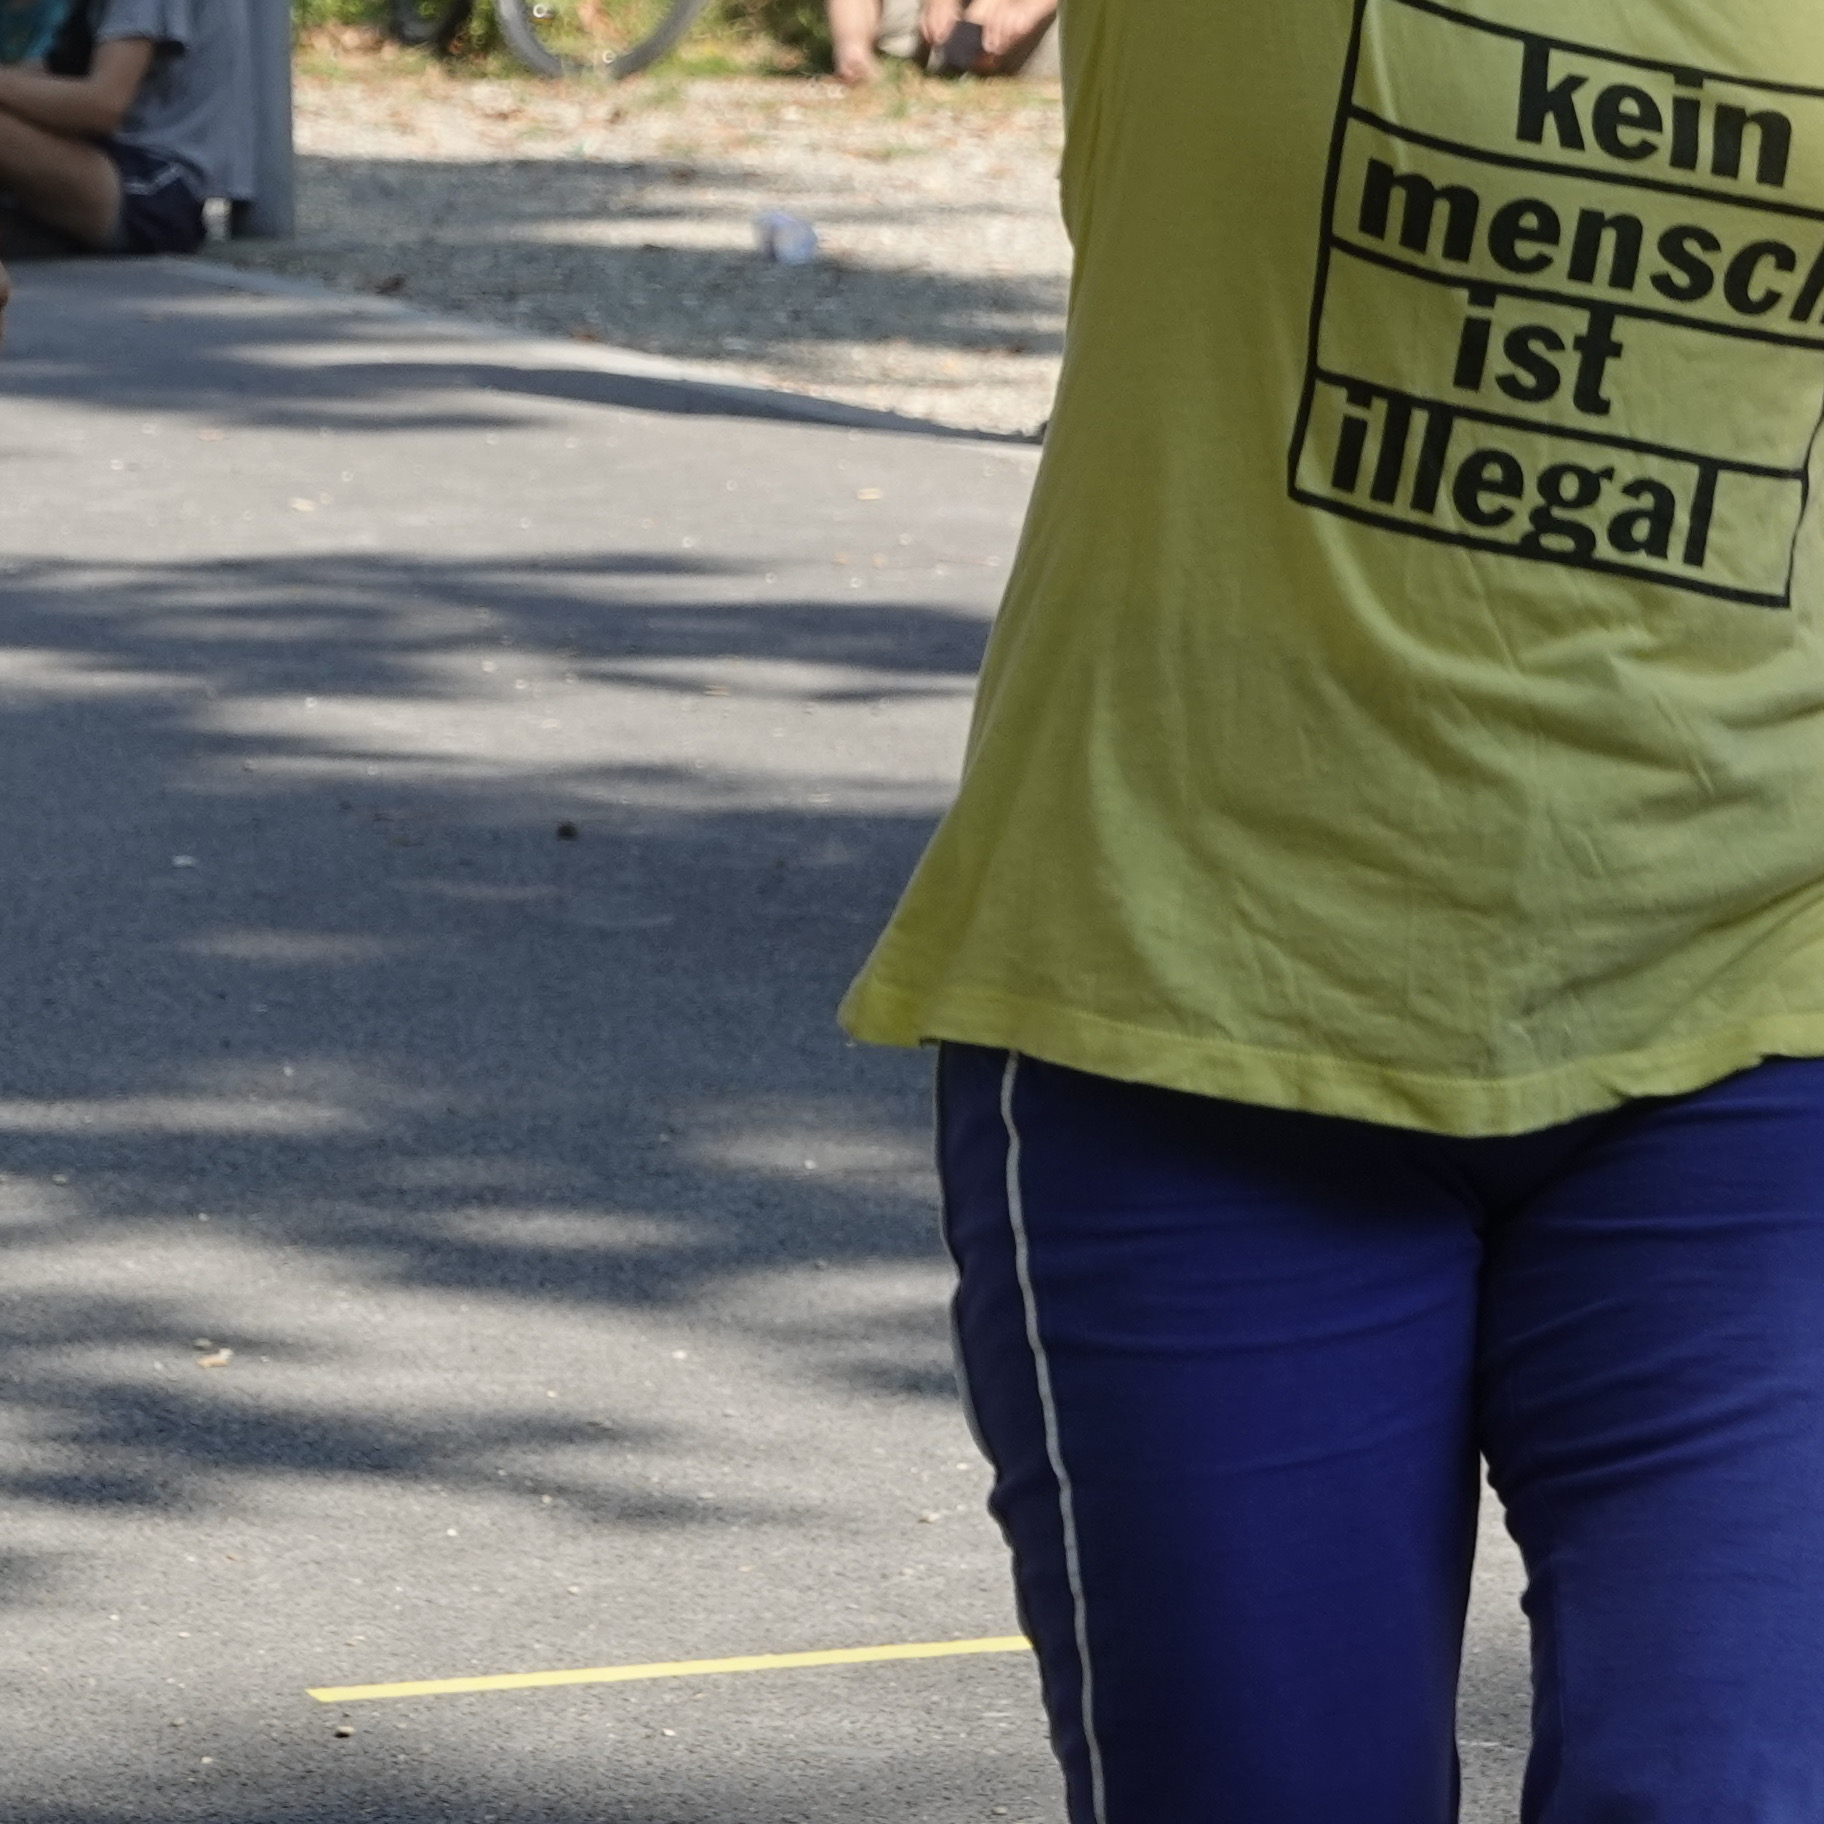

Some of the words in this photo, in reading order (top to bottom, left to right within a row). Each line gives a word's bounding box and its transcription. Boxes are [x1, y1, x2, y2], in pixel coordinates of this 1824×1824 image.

[1515, 35, 1792, 187] kein
[1454, 288, 1623, 416] ist
[1331, 386, 1719, 569] illegal
